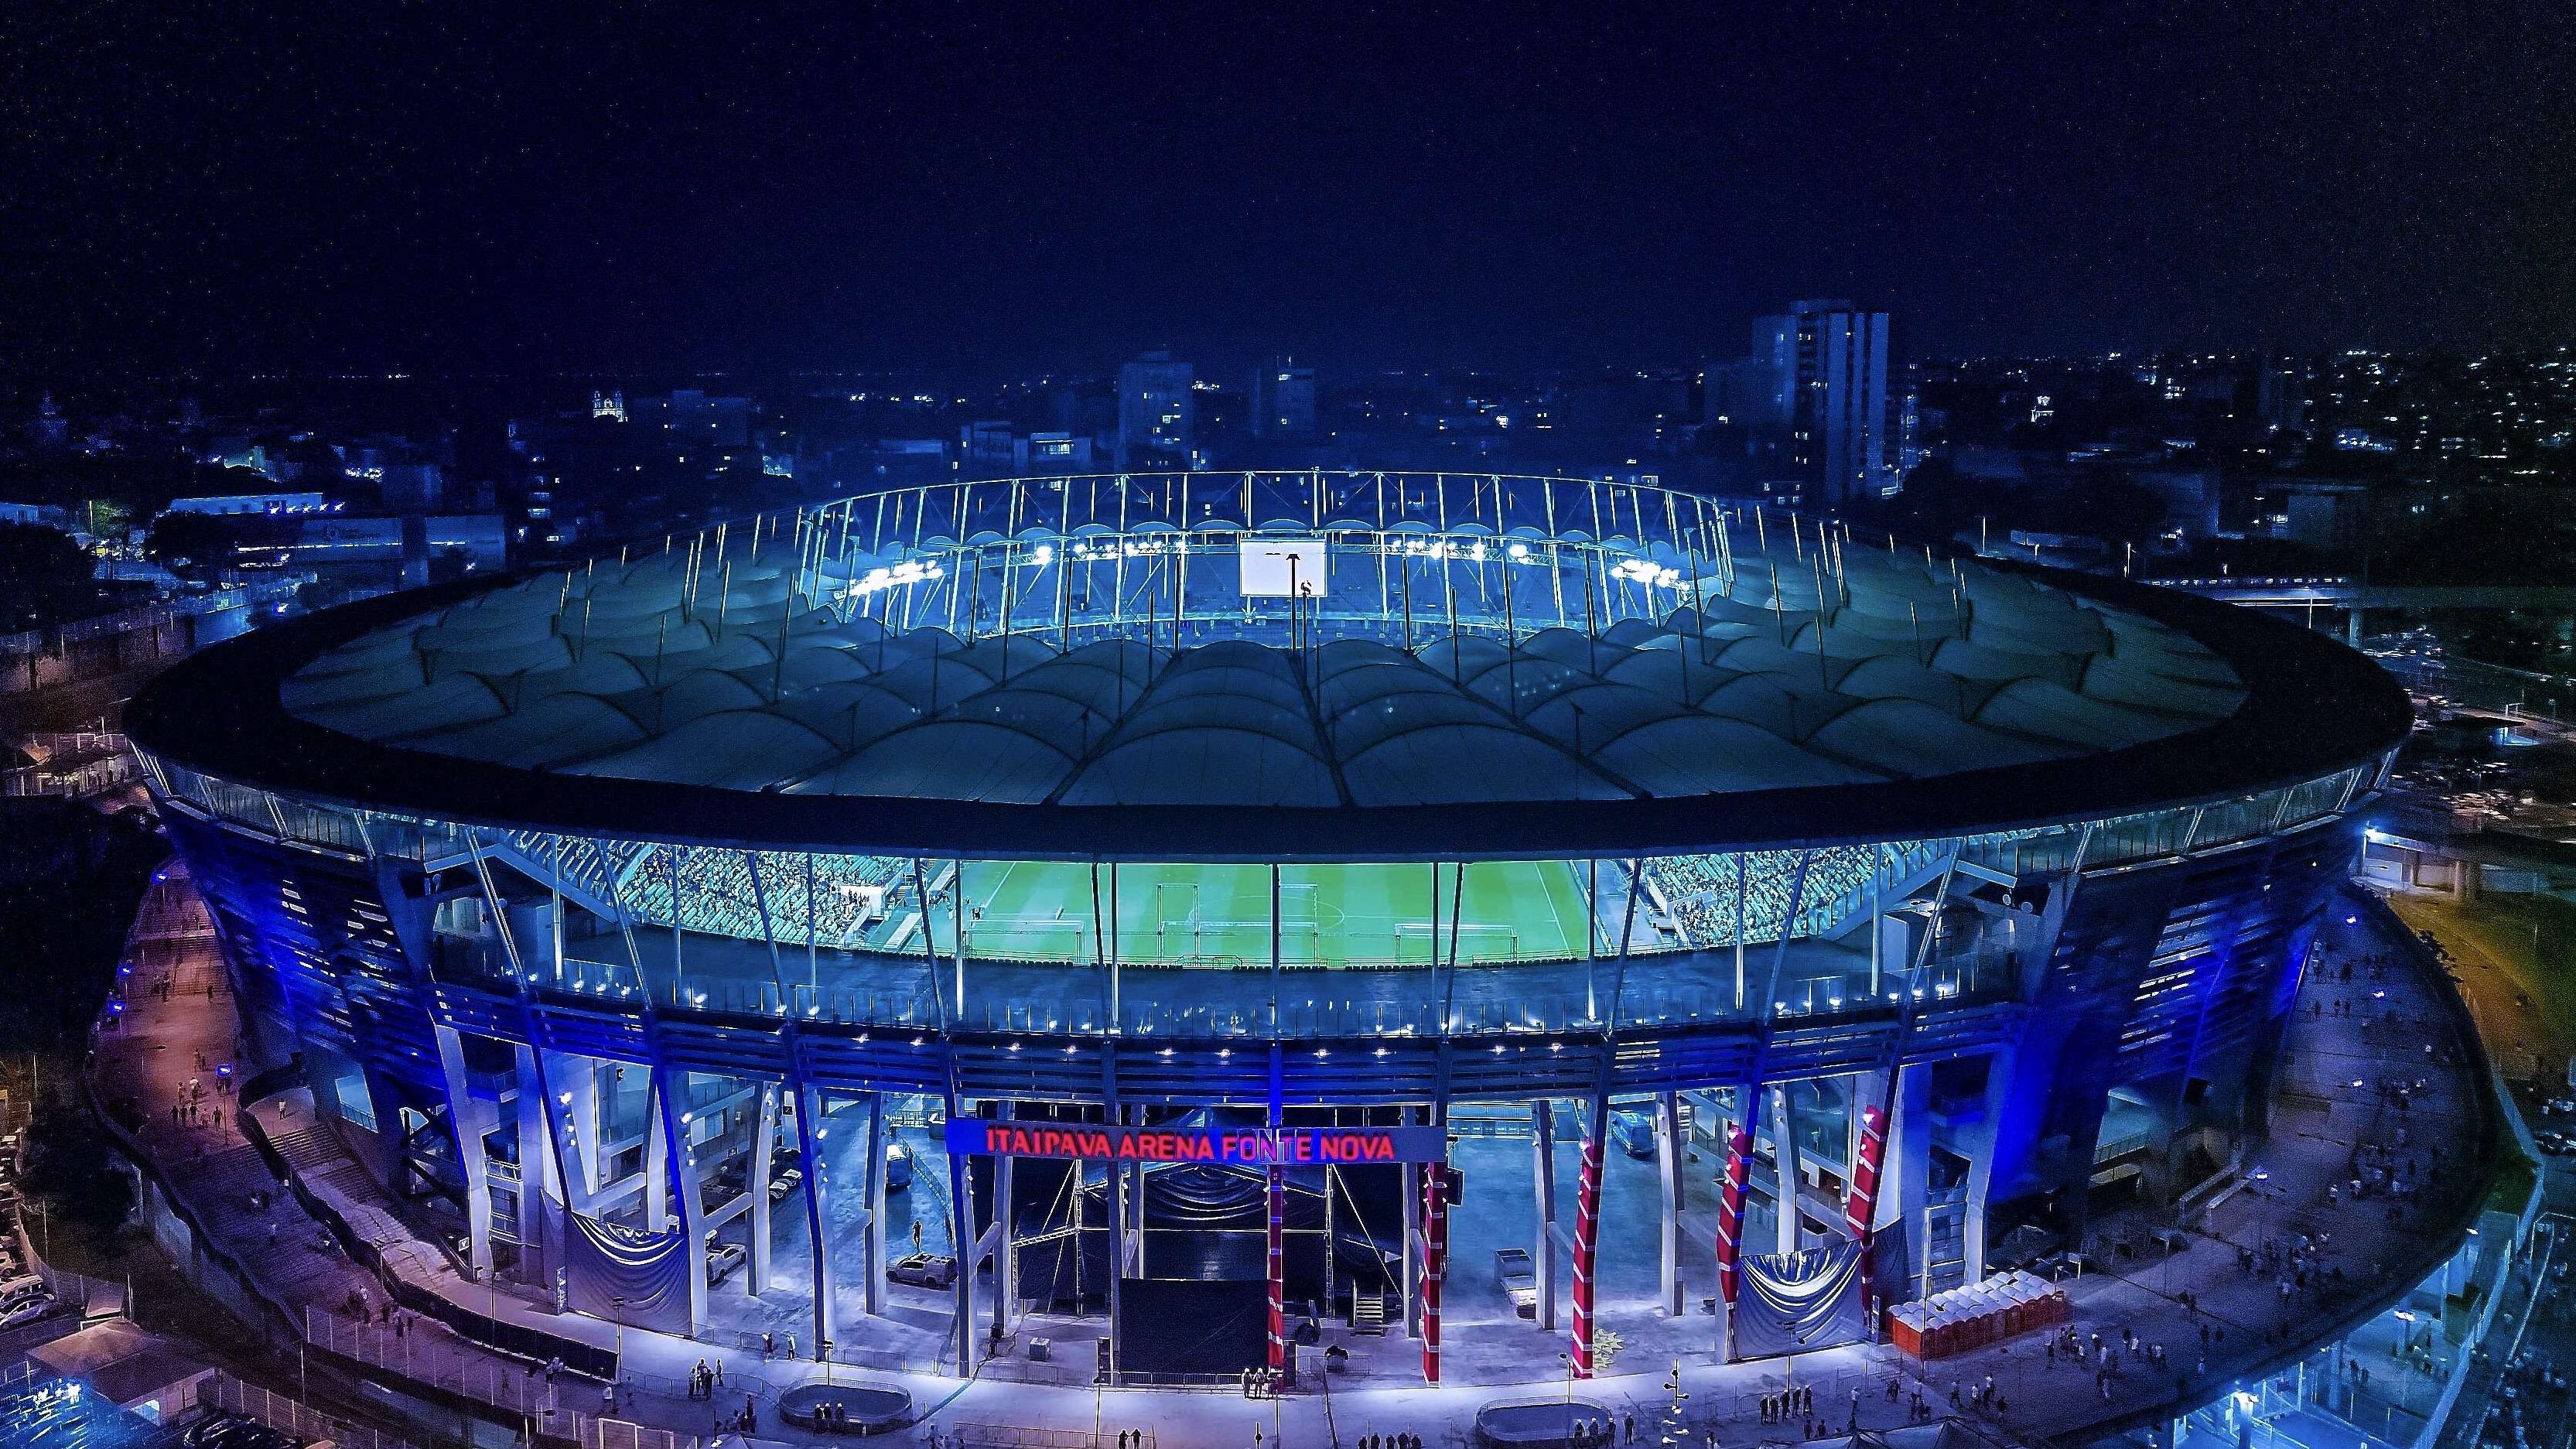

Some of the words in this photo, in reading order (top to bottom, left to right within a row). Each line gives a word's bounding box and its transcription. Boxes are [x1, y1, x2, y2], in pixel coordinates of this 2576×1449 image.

[986, 1127, 1112, 1158] ITAIPAVA
[1119, 1133, 1215, 1159] ARENA
[1221, 1133, 1313, 1160] FONTE
[1321, 1134, 1395, 1160] NOVA
